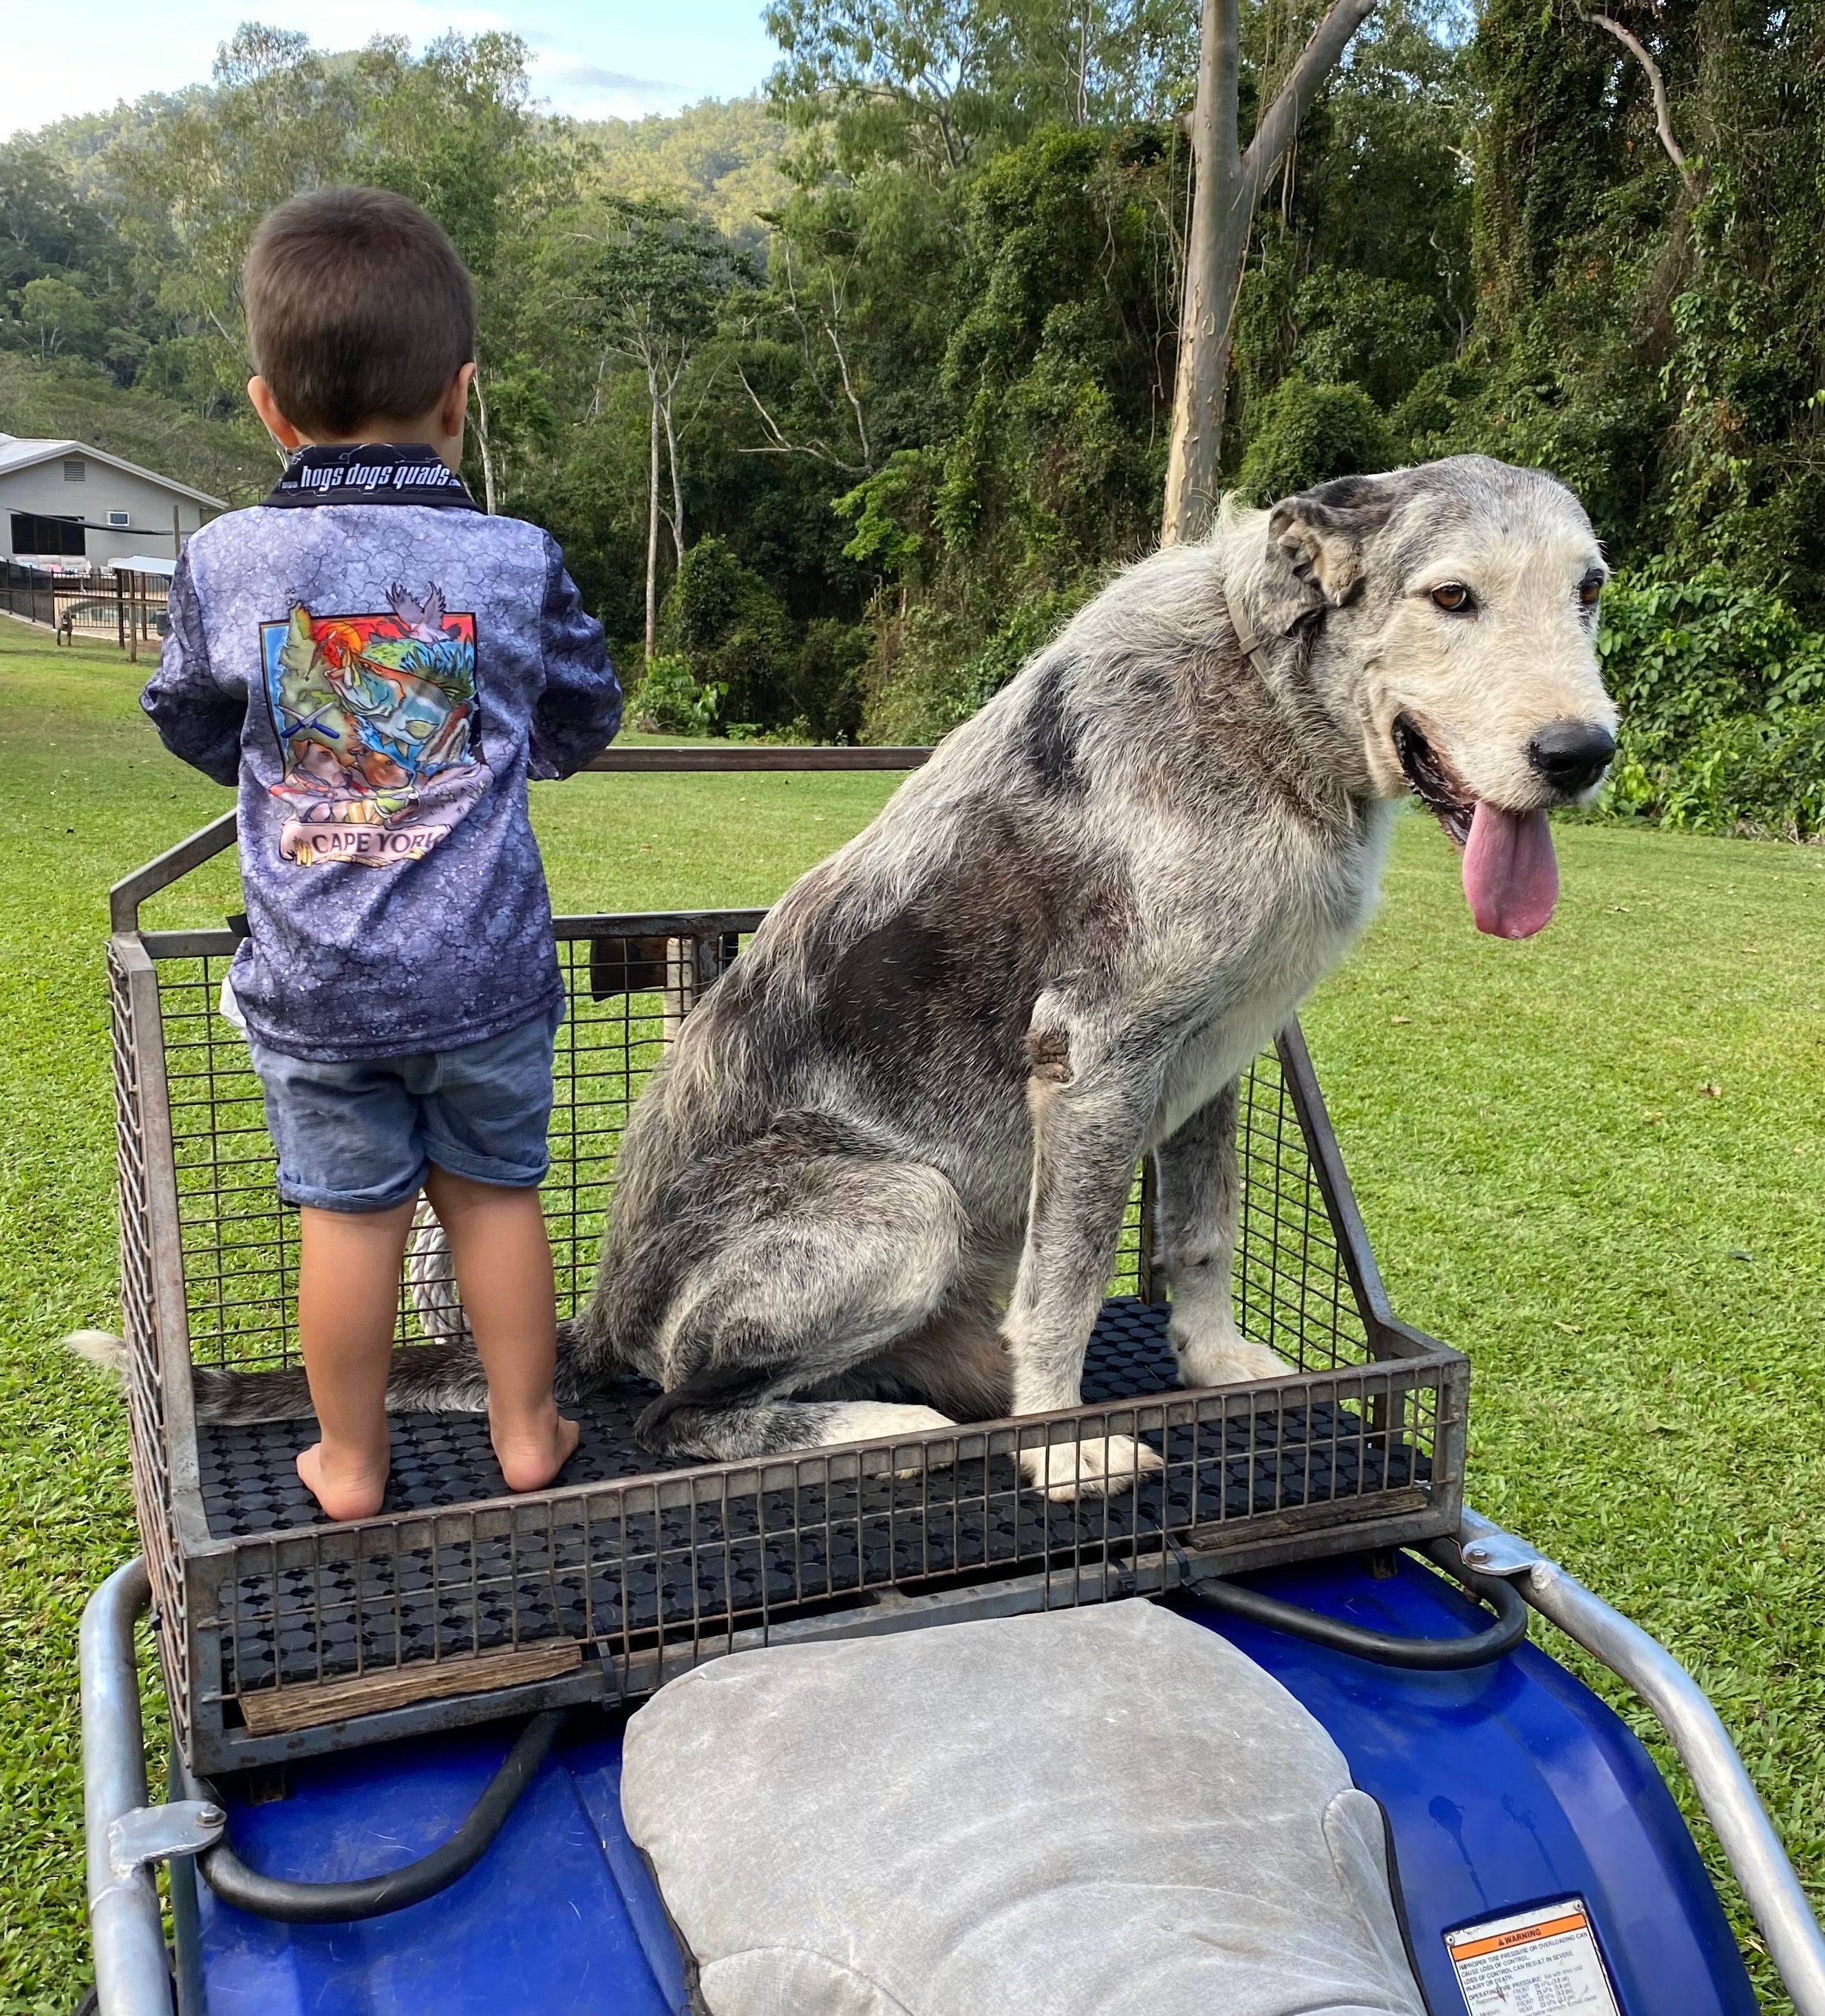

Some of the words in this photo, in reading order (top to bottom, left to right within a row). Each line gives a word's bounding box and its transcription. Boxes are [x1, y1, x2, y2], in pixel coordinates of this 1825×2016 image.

[301, 466, 344, 492] hogs
[345, 463, 392, 490] dogs
[393, 464, 451, 490] quads
[312, 833, 370, 853] CAPE
[1505, 1929, 1541, 1944] WARNING
[1459, 1959, 1487, 1971] IMPROPER
[1501, 1947, 1529, 1959] PRESSURE
[1539, 1935, 1576, 1949] OVERLOADING
[1461, 1969, 1480, 1977] CAUSE
[1464, 1977, 1478, 1985] LOSS
[1486, 1967, 1513, 1979] CONTROL
[1525, 1958, 1546, 1968] RESULT
[1552, 1951, 1574, 1960] SEVERE
[1466, 1982, 1485, 1991] INJURY
